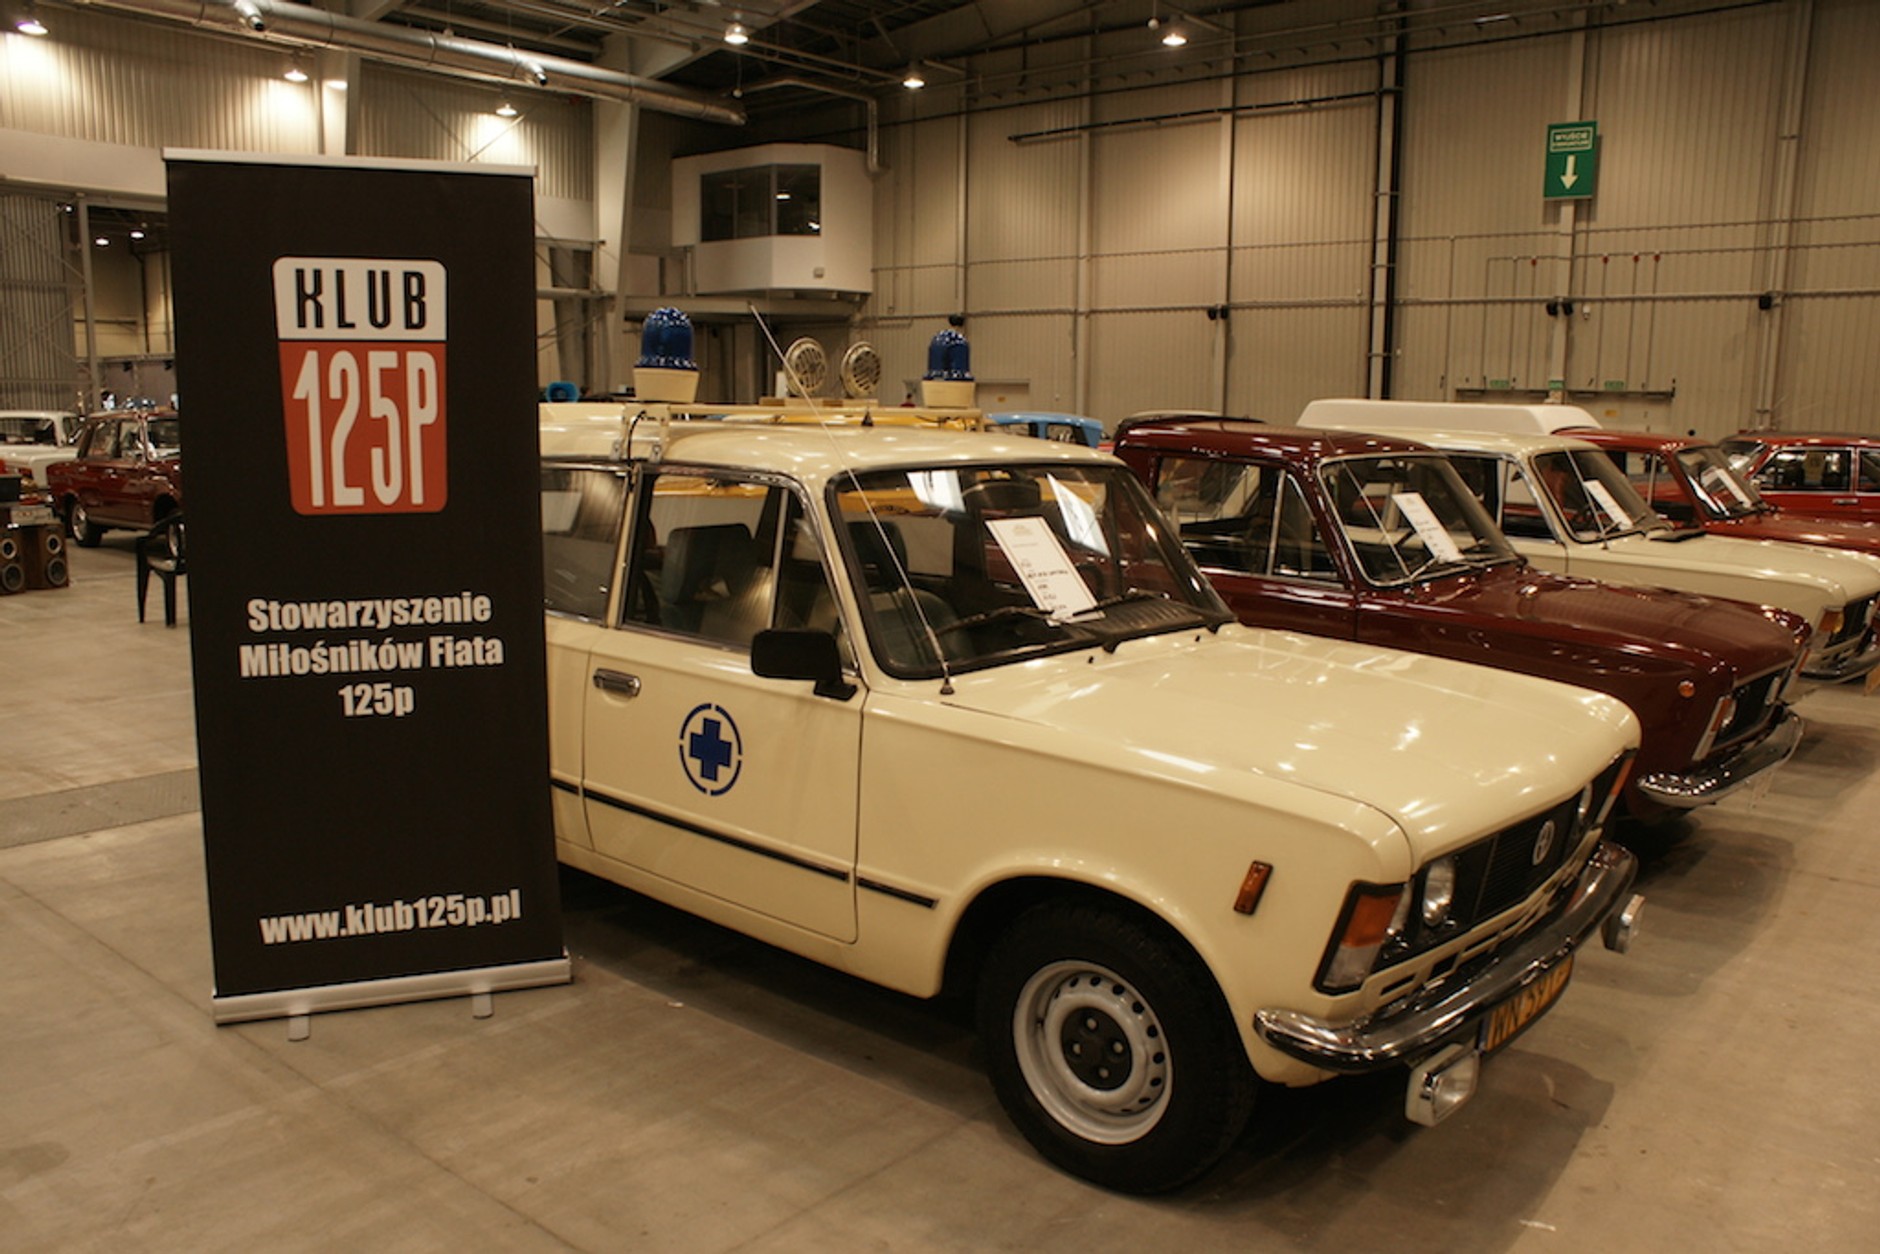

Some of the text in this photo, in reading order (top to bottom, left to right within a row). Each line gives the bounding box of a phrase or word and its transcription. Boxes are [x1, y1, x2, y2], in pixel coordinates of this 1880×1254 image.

[296, 268, 427, 330] KLUB
[293, 349, 439, 507] 125P
[247, 591, 493, 632] Stowarzyszenie
[239, 634, 505, 678] Miłośników Fiata
[338, 682, 415, 717] 125p
[259, 888, 522, 945] www.klub125p.pl
